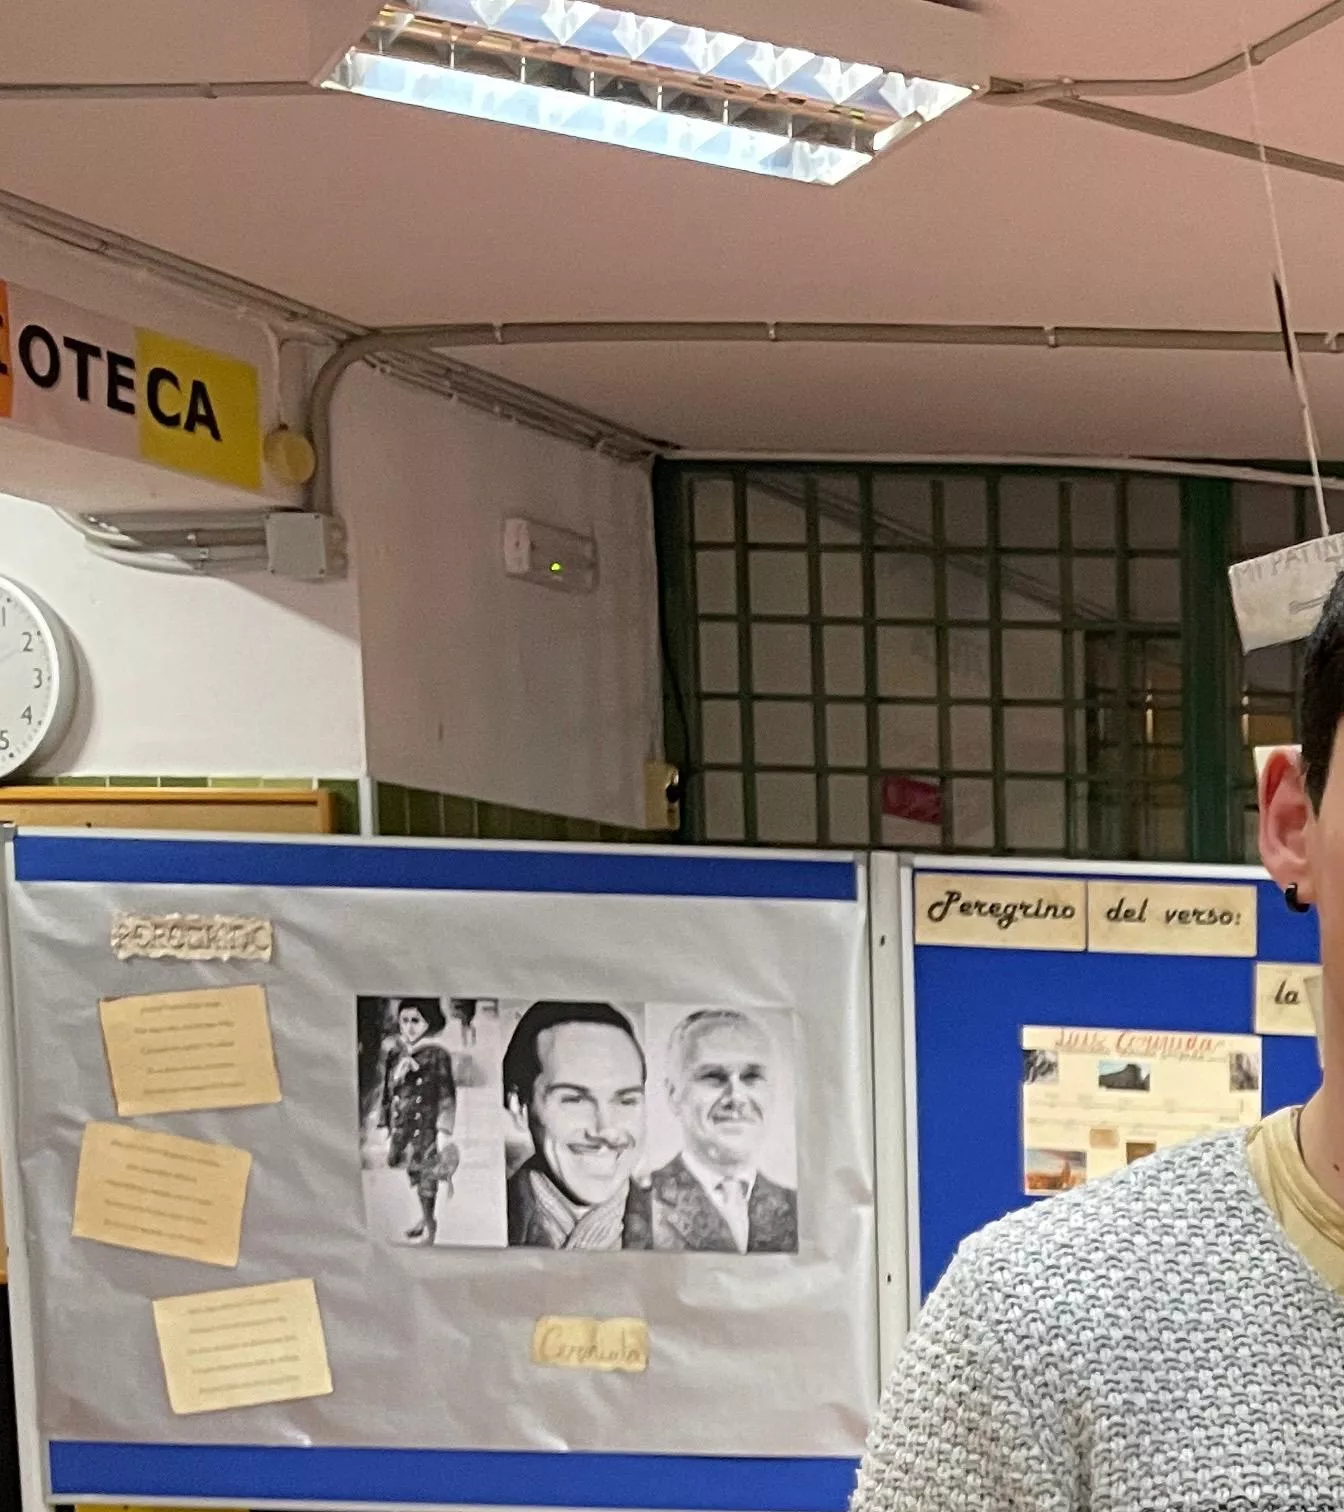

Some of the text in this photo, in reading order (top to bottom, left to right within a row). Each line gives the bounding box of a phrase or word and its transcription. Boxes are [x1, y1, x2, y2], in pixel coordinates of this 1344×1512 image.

[0, 315, 223, 442] OTECA
[21, 632, 33, 652] 2
[33, 667, 42, 689] 3
[21, 704, 32, 725] 4
[0, 730, 9, 750] 5
[927, 889, 1241, 929] Peregrino del verso:
[1274, 980, 1300, 1006] la
